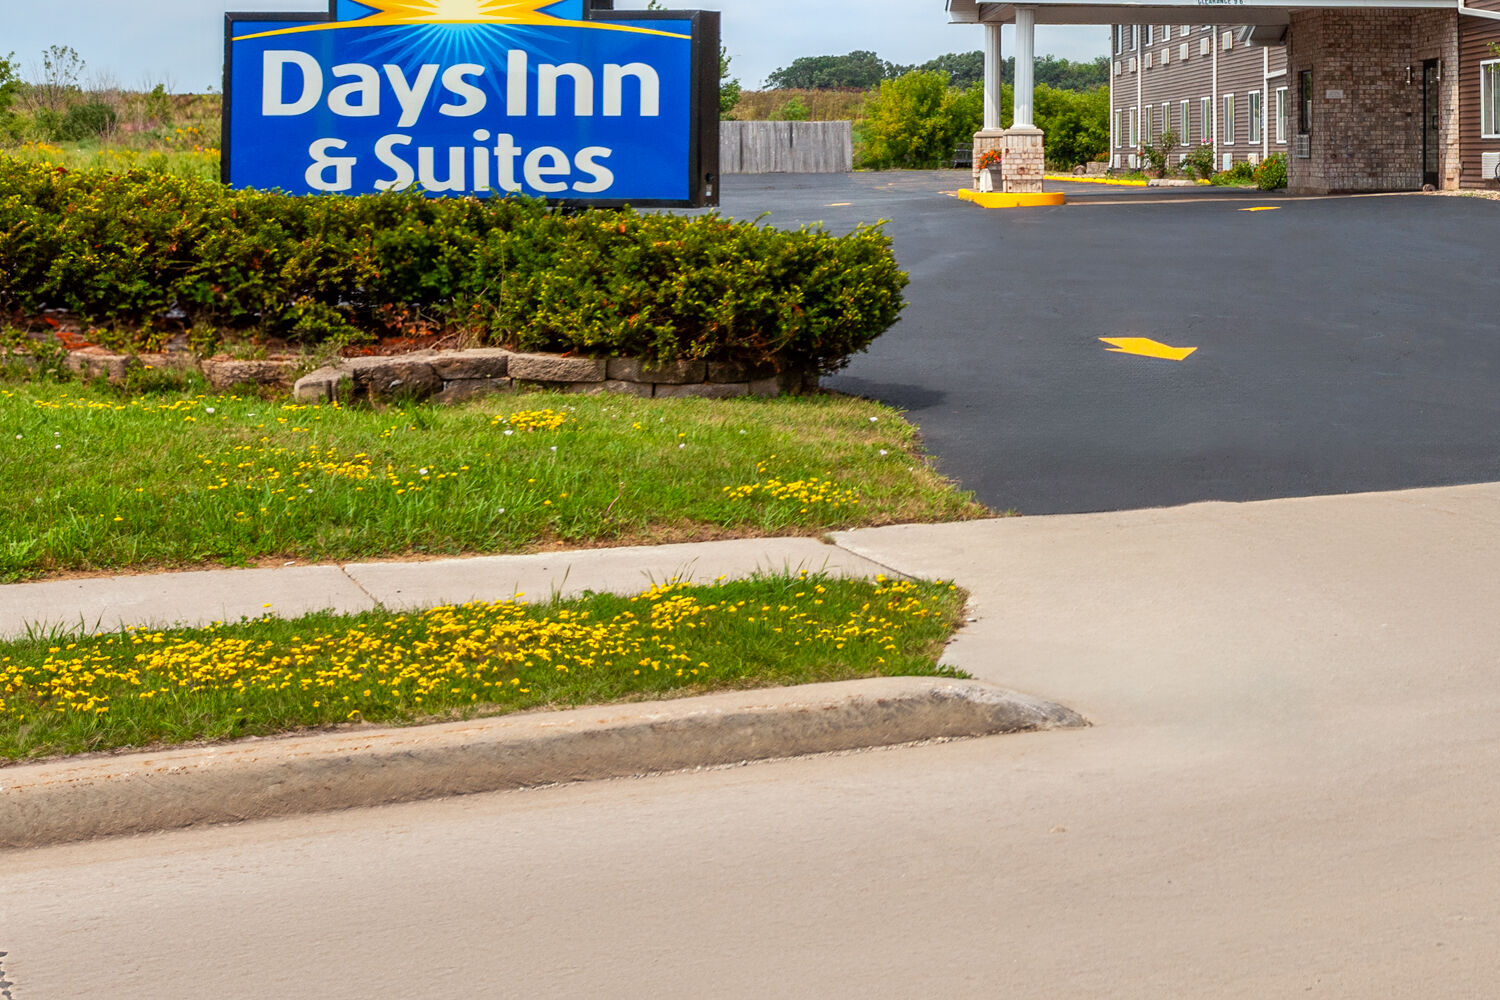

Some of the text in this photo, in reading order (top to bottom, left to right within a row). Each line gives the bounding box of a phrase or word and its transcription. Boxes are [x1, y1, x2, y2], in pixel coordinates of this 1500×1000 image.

[262, 50, 660, 127] Days Inn
[304, 128, 615, 193] & Suites
